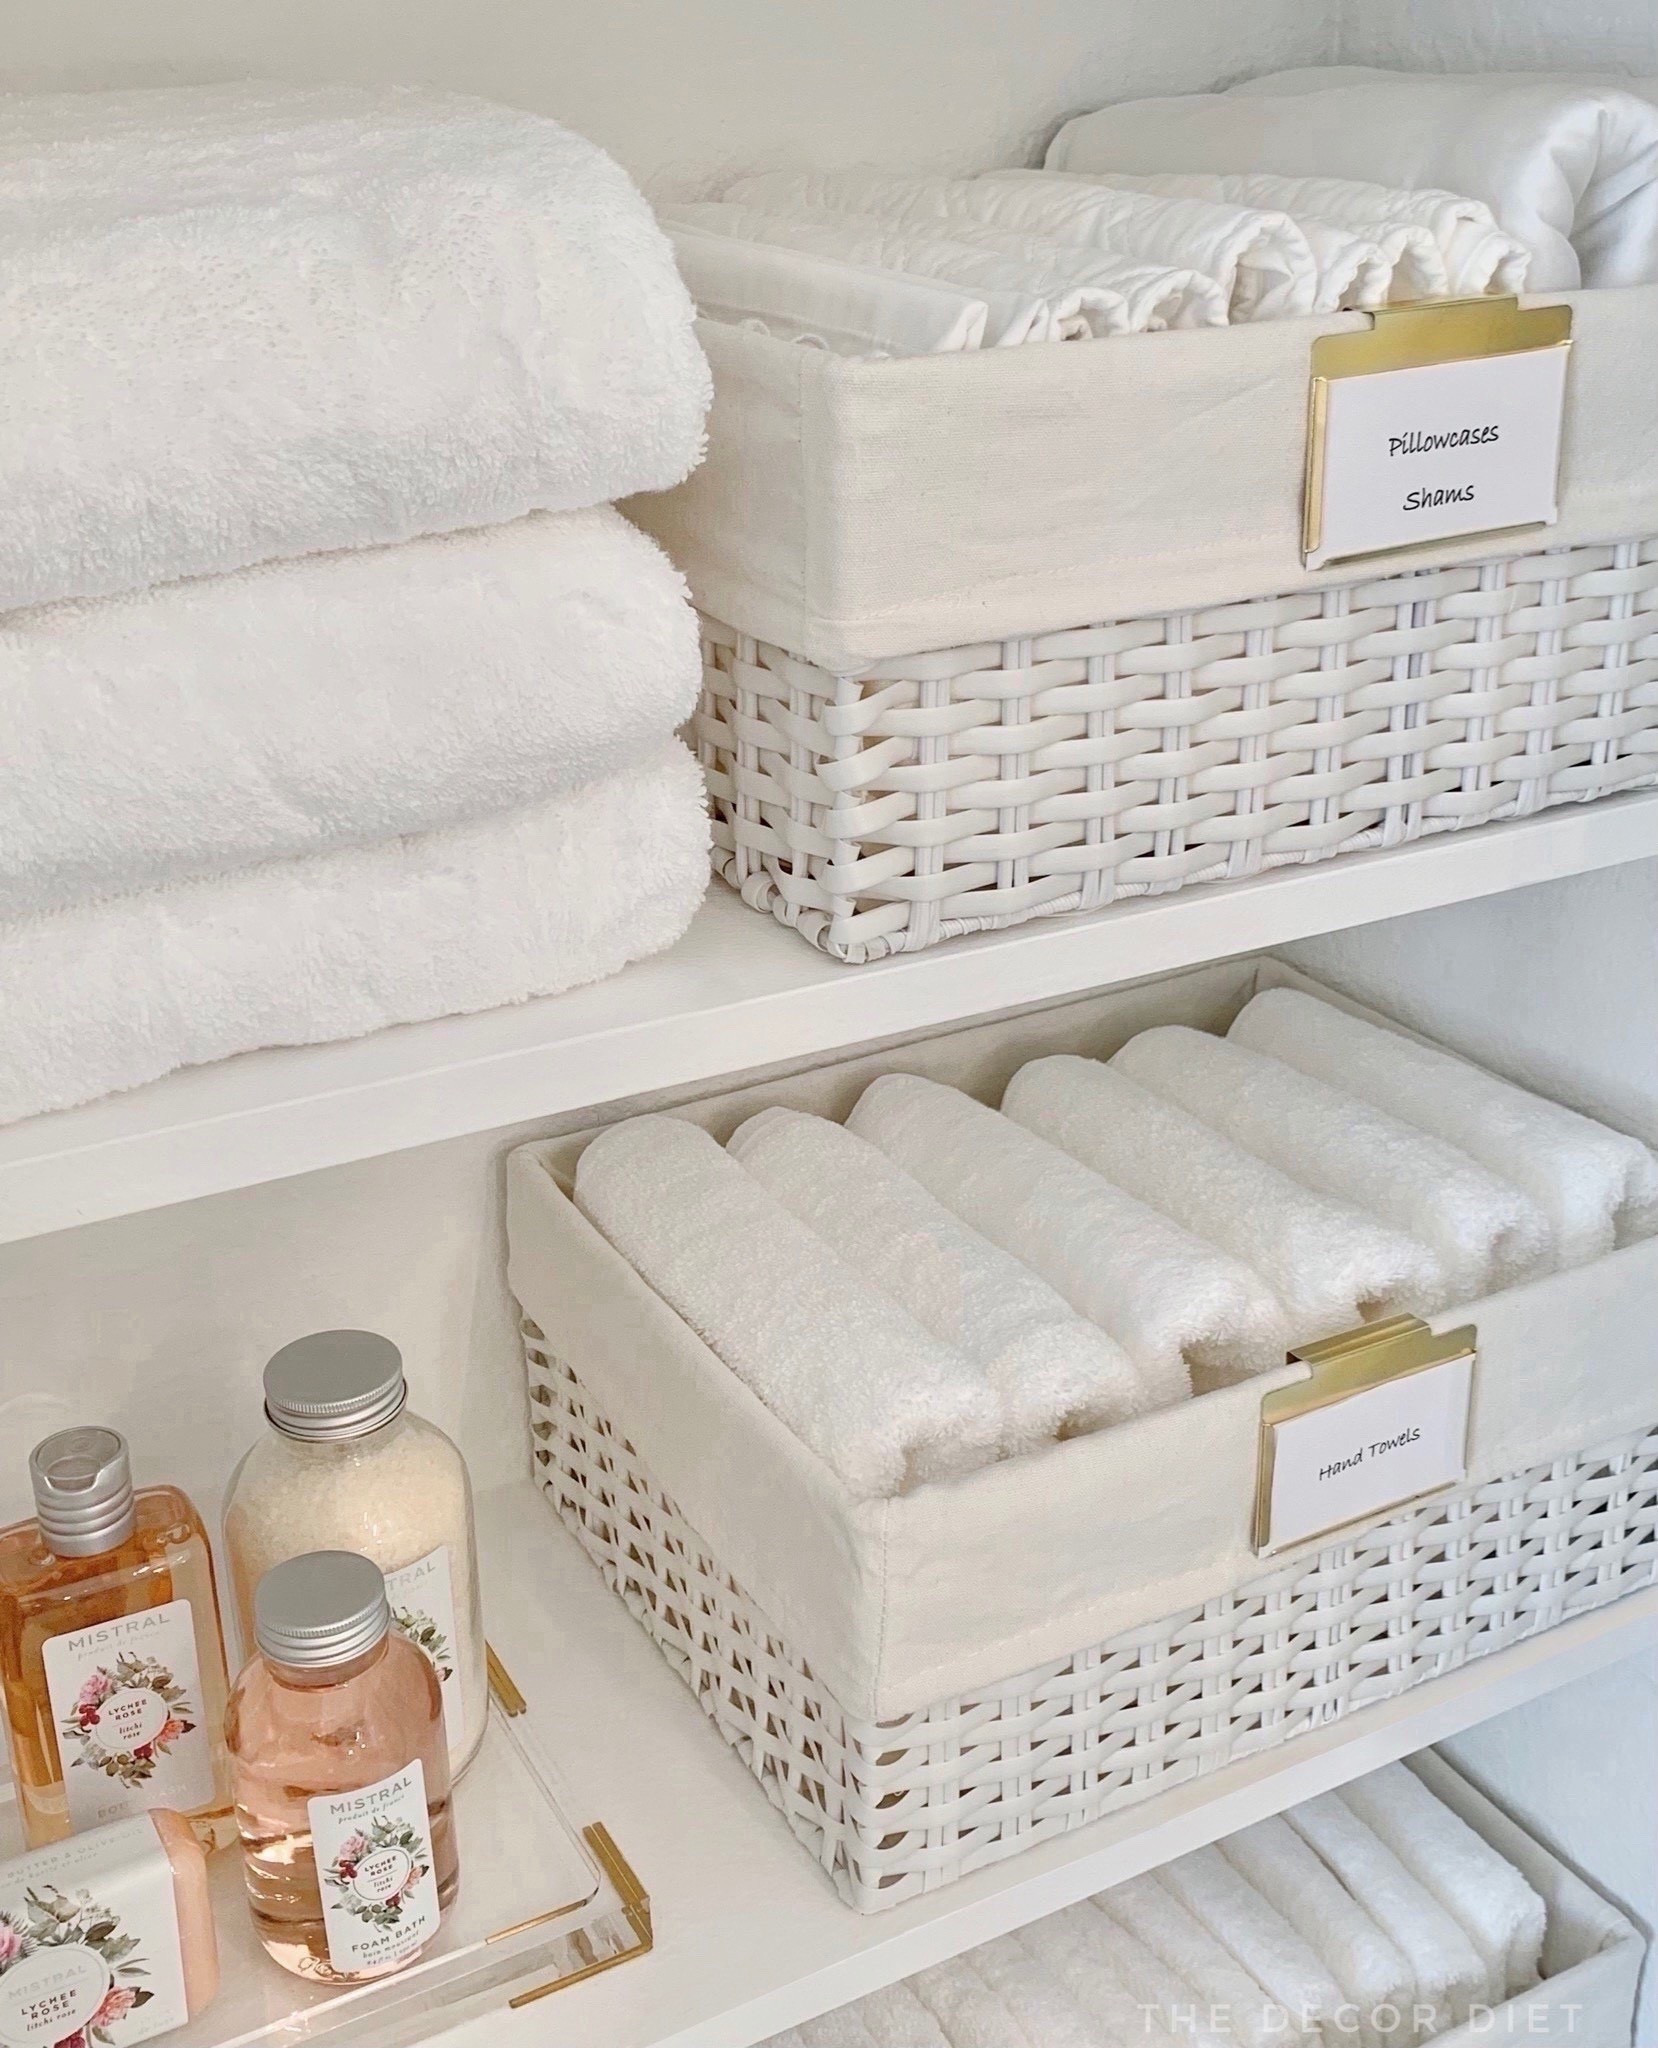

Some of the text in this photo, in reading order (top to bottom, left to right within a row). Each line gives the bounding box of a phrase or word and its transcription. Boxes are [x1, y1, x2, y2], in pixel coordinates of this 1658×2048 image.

[1389, 424, 1499, 457] Pillowcases
[1402, 484, 1475, 511] Shams
[1318, 1427, 1421, 1481] Hand Towels
[386, 1561, 436, 1591] TRAL
[68, 1613, 171, 1651] MISTRAL
[108, 1699, 148, 1716] LYCHEE
[115, 1708, 143, 1721] ROSE
[119, 1721, 143, 1735] litchi
[330, 1777, 412, 1815] MISTRAL
[364, 1855, 397, 1872] LYCHEE
[370, 1864, 394, 1876] ROSE
[351, 1915, 425, 1952] FOAM BATH
[8, 1965, 87, 2000] MISTRAL
[21, 1989, 77, 2015] LYCHEE
[31, 2000, 70, 2020] ROSE
[26, 2009, 77, 2032] litchi rose
